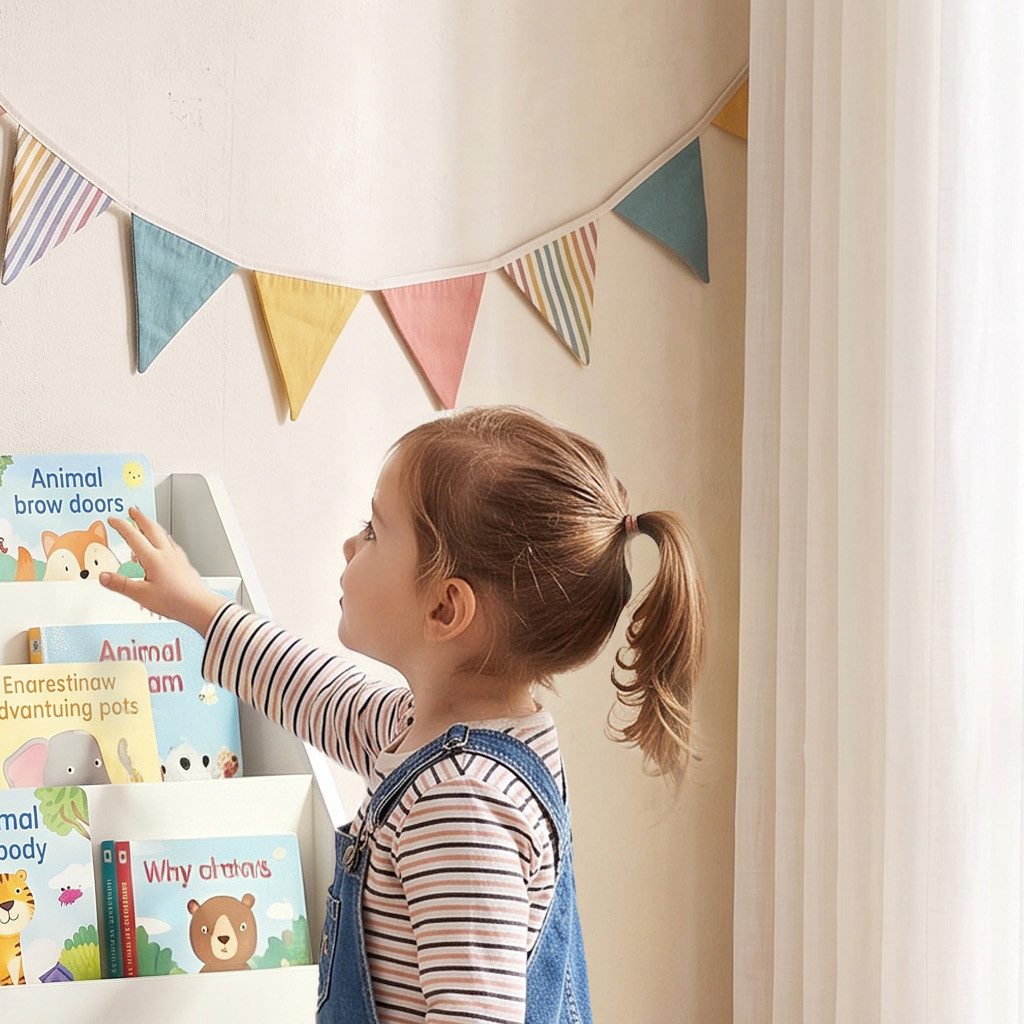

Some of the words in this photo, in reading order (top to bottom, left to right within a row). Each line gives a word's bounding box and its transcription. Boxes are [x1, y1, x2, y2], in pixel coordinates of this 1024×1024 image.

[31, 466, 103, 489] Animal
[14, 495, 62, 515] brow
[69, 493, 124, 514] doors
[99, 637, 182, 662] Animal
[3, 674, 117, 695] Enarestinaw
[99, 698, 140, 722] pots
[143, 858, 192, 888] Why
